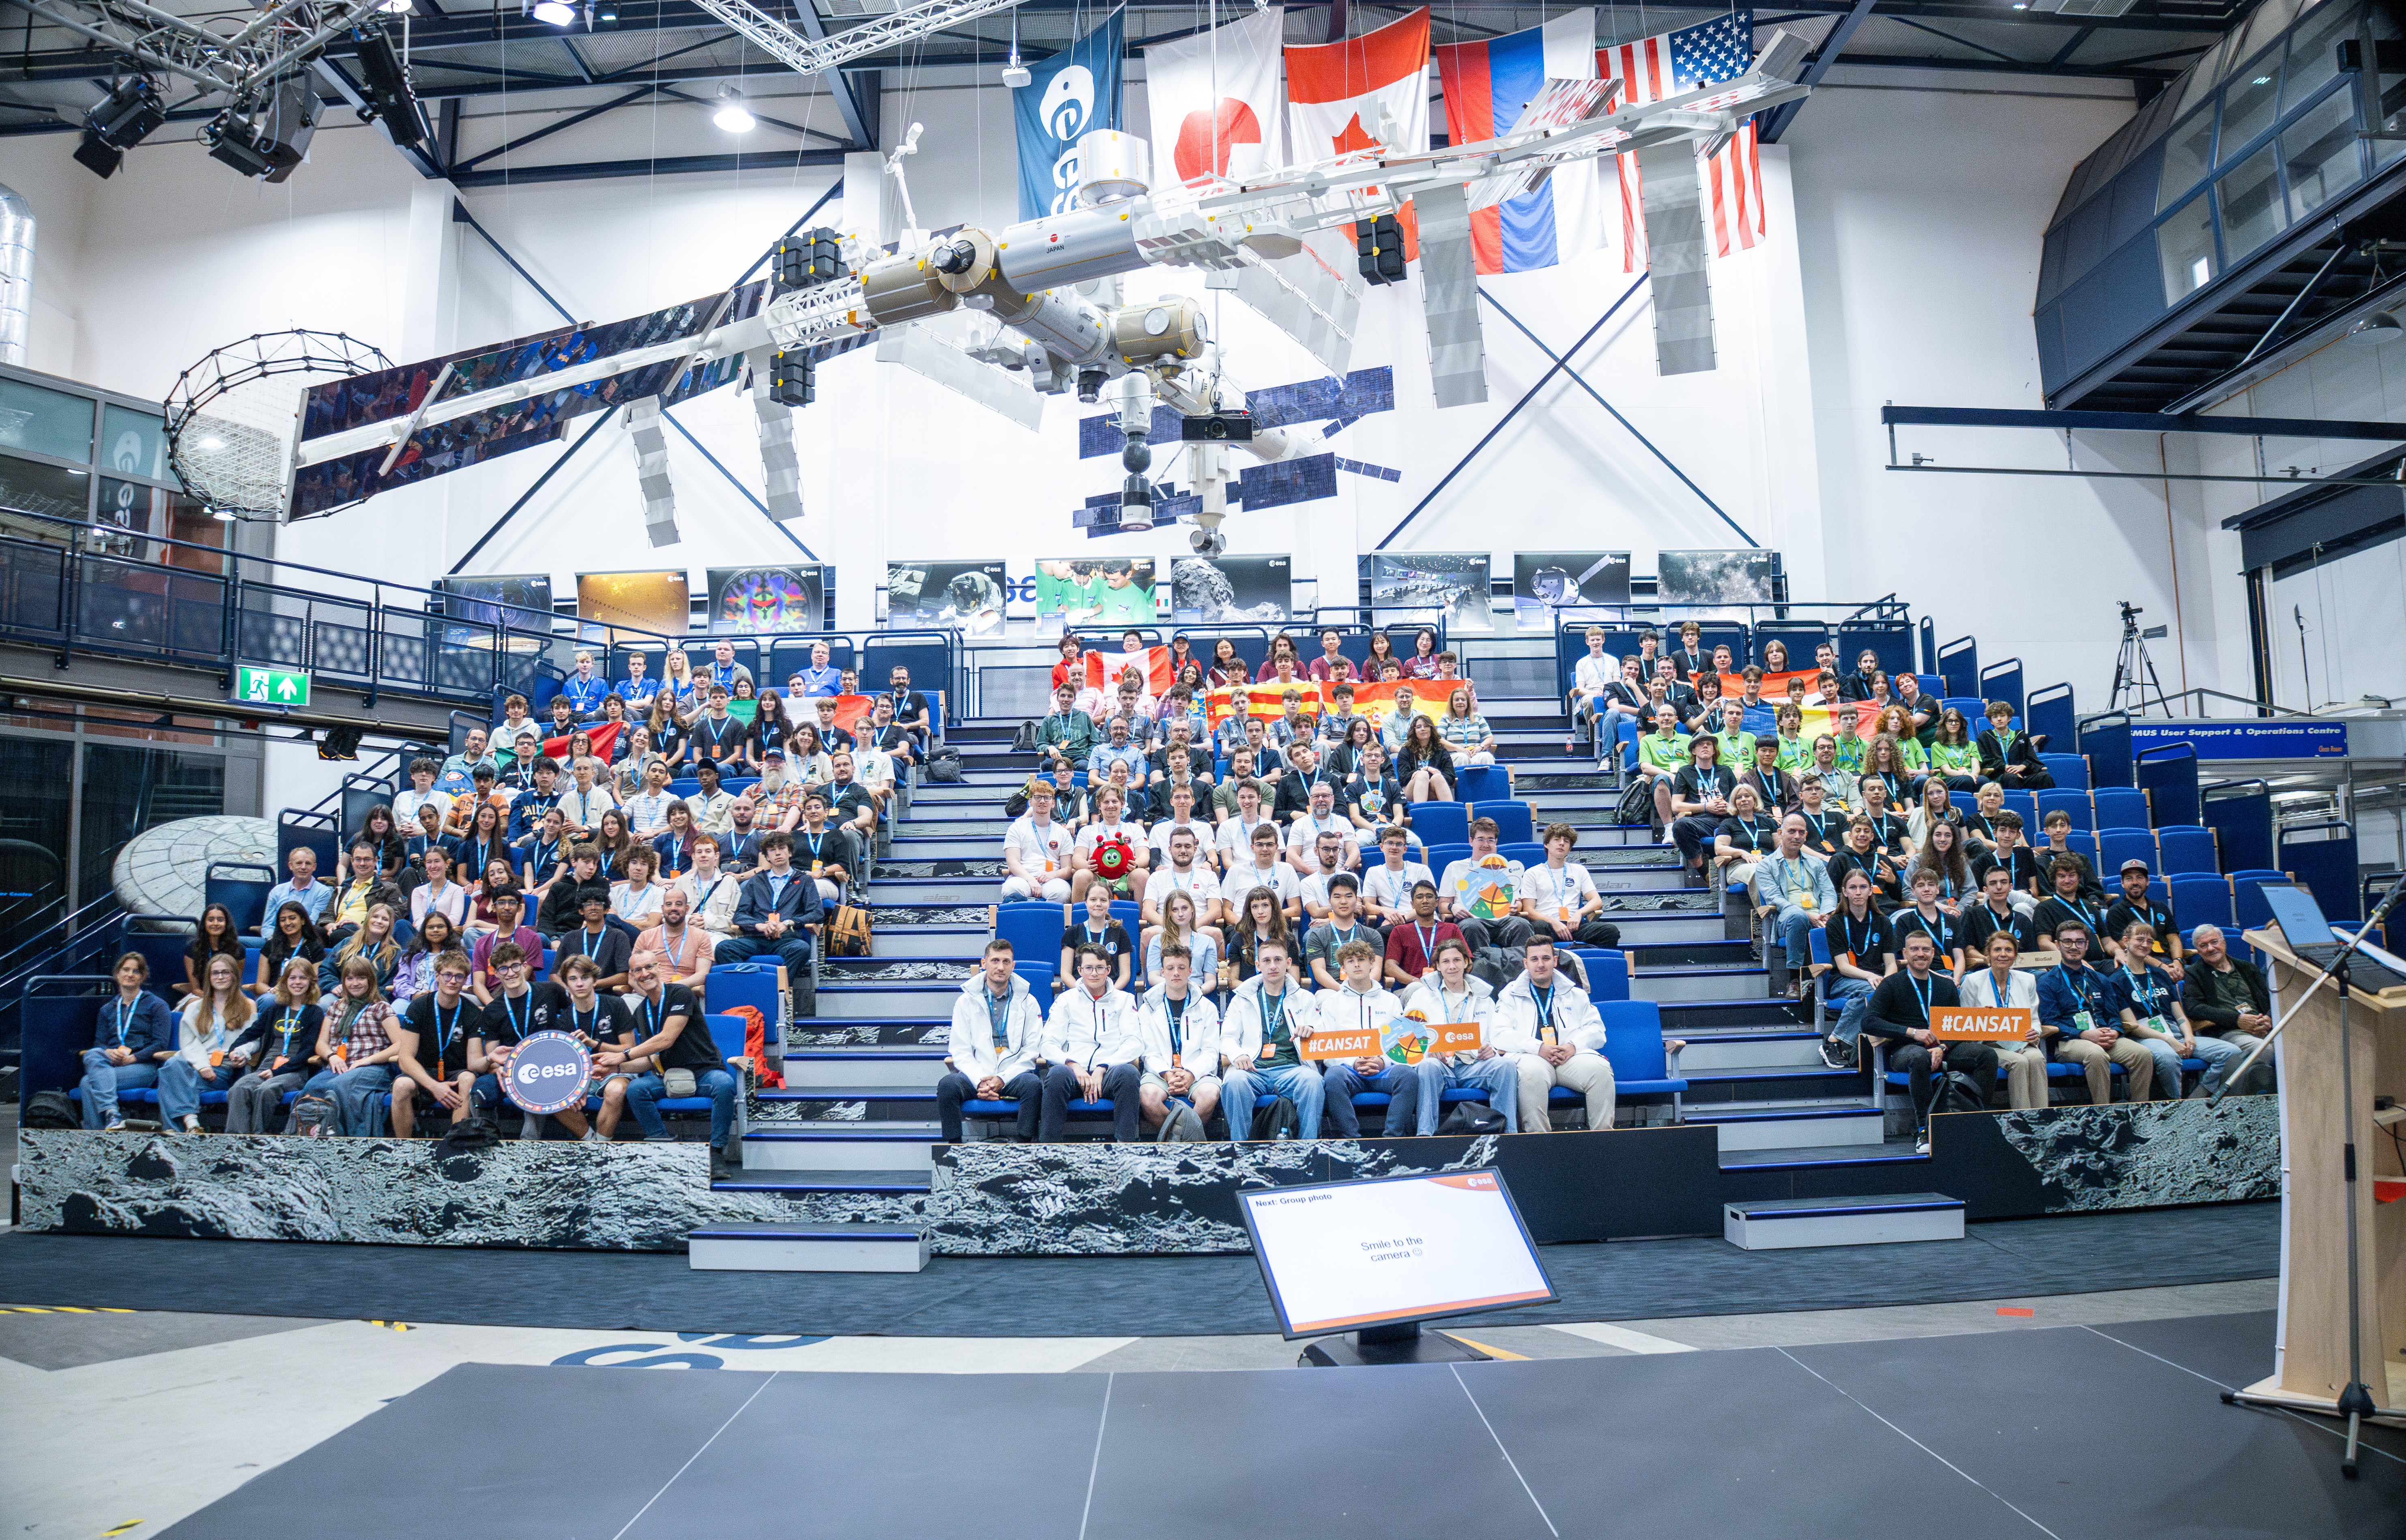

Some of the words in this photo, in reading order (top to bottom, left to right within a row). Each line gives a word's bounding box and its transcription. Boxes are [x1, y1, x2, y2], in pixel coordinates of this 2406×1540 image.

[1046, 245, 1064, 253] JAPAN
[2189, 729, 2230, 737] Support
[2246, 727, 2304, 736] Operations
[1942, 1015, 2023, 1032] #CANSAT
[1456, 1033, 1474, 1041] esa
[1308, 1036, 1371, 1052] #CANSAT
[541, 1062, 577, 1078] esa
[1308, 1194, 1332, 1203] photo
[1361, 1240, 1391, 1251] Smile
[1406, 1237, 1423, 1245] the
[1371, 1251, 1410, 1262] camera
